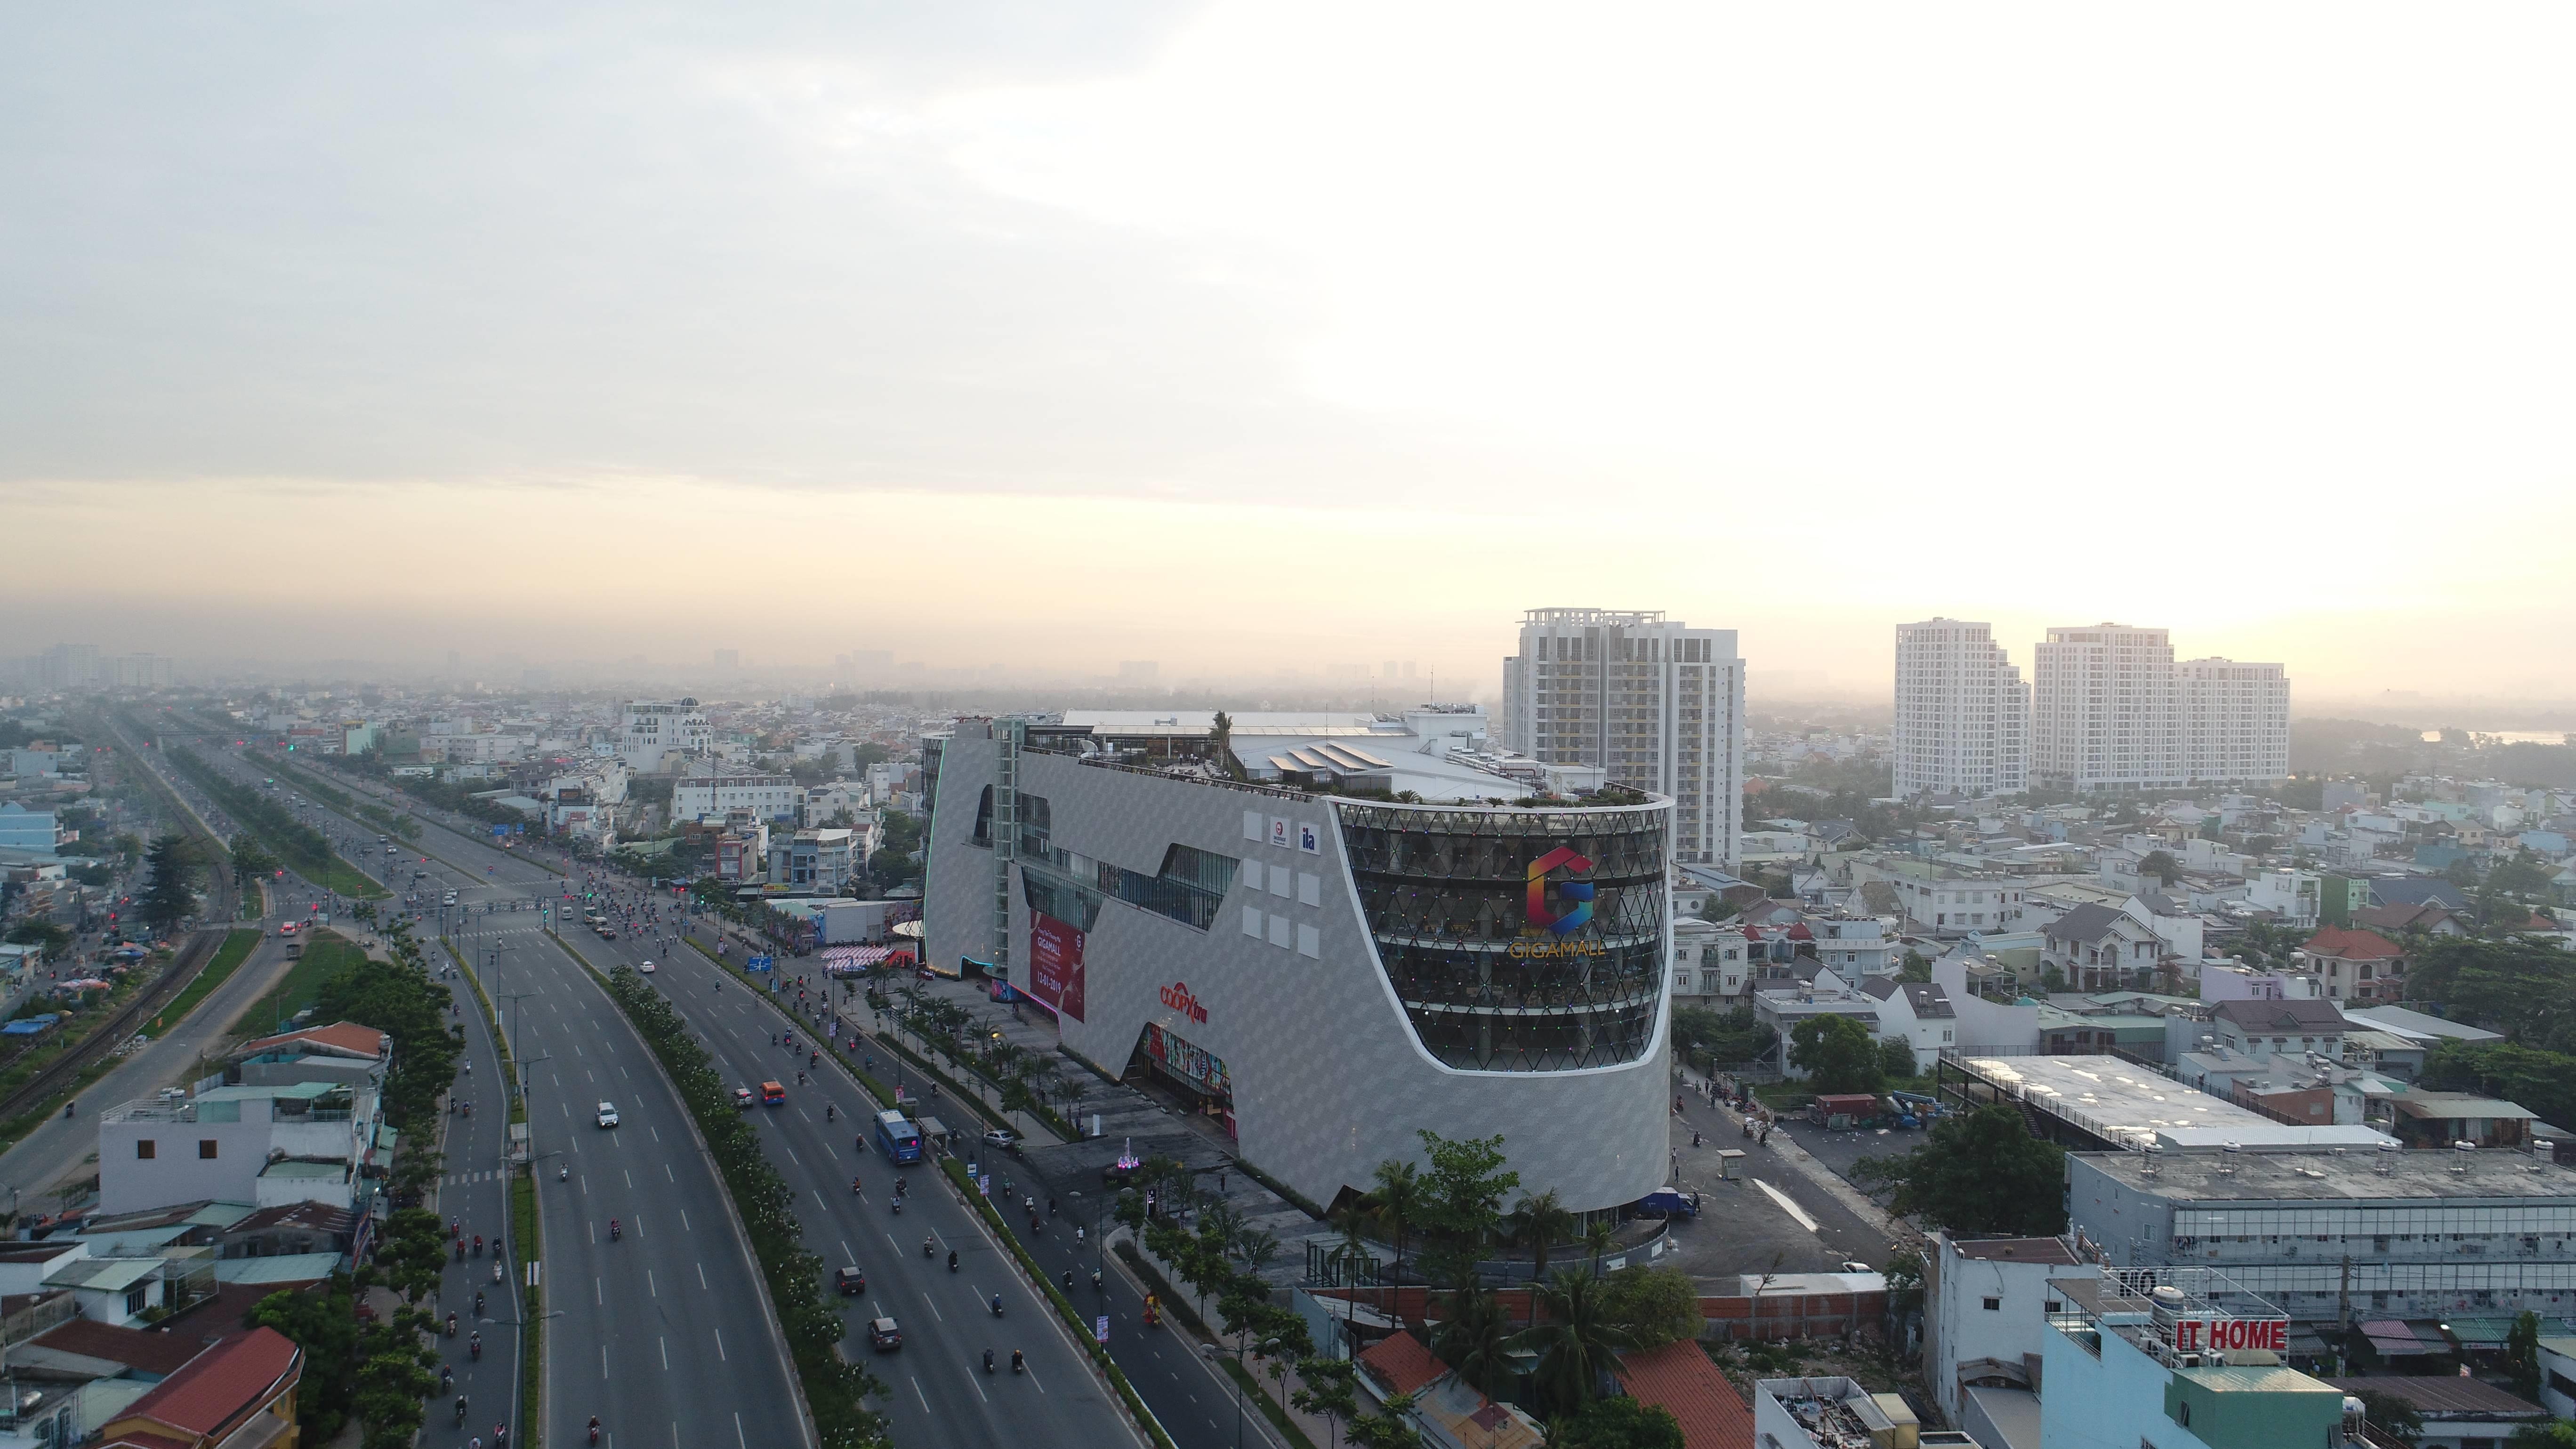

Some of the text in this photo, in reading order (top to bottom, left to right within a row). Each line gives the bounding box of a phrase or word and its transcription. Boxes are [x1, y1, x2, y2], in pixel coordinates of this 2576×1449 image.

[1303, 827, 1314, 850] ila
[1038, 936, 1061, 957] GIGAMALL
[1510, 940, 1605, 958] GIGAMALL
[2176, 1319, 2286, 1350] IT HOME
